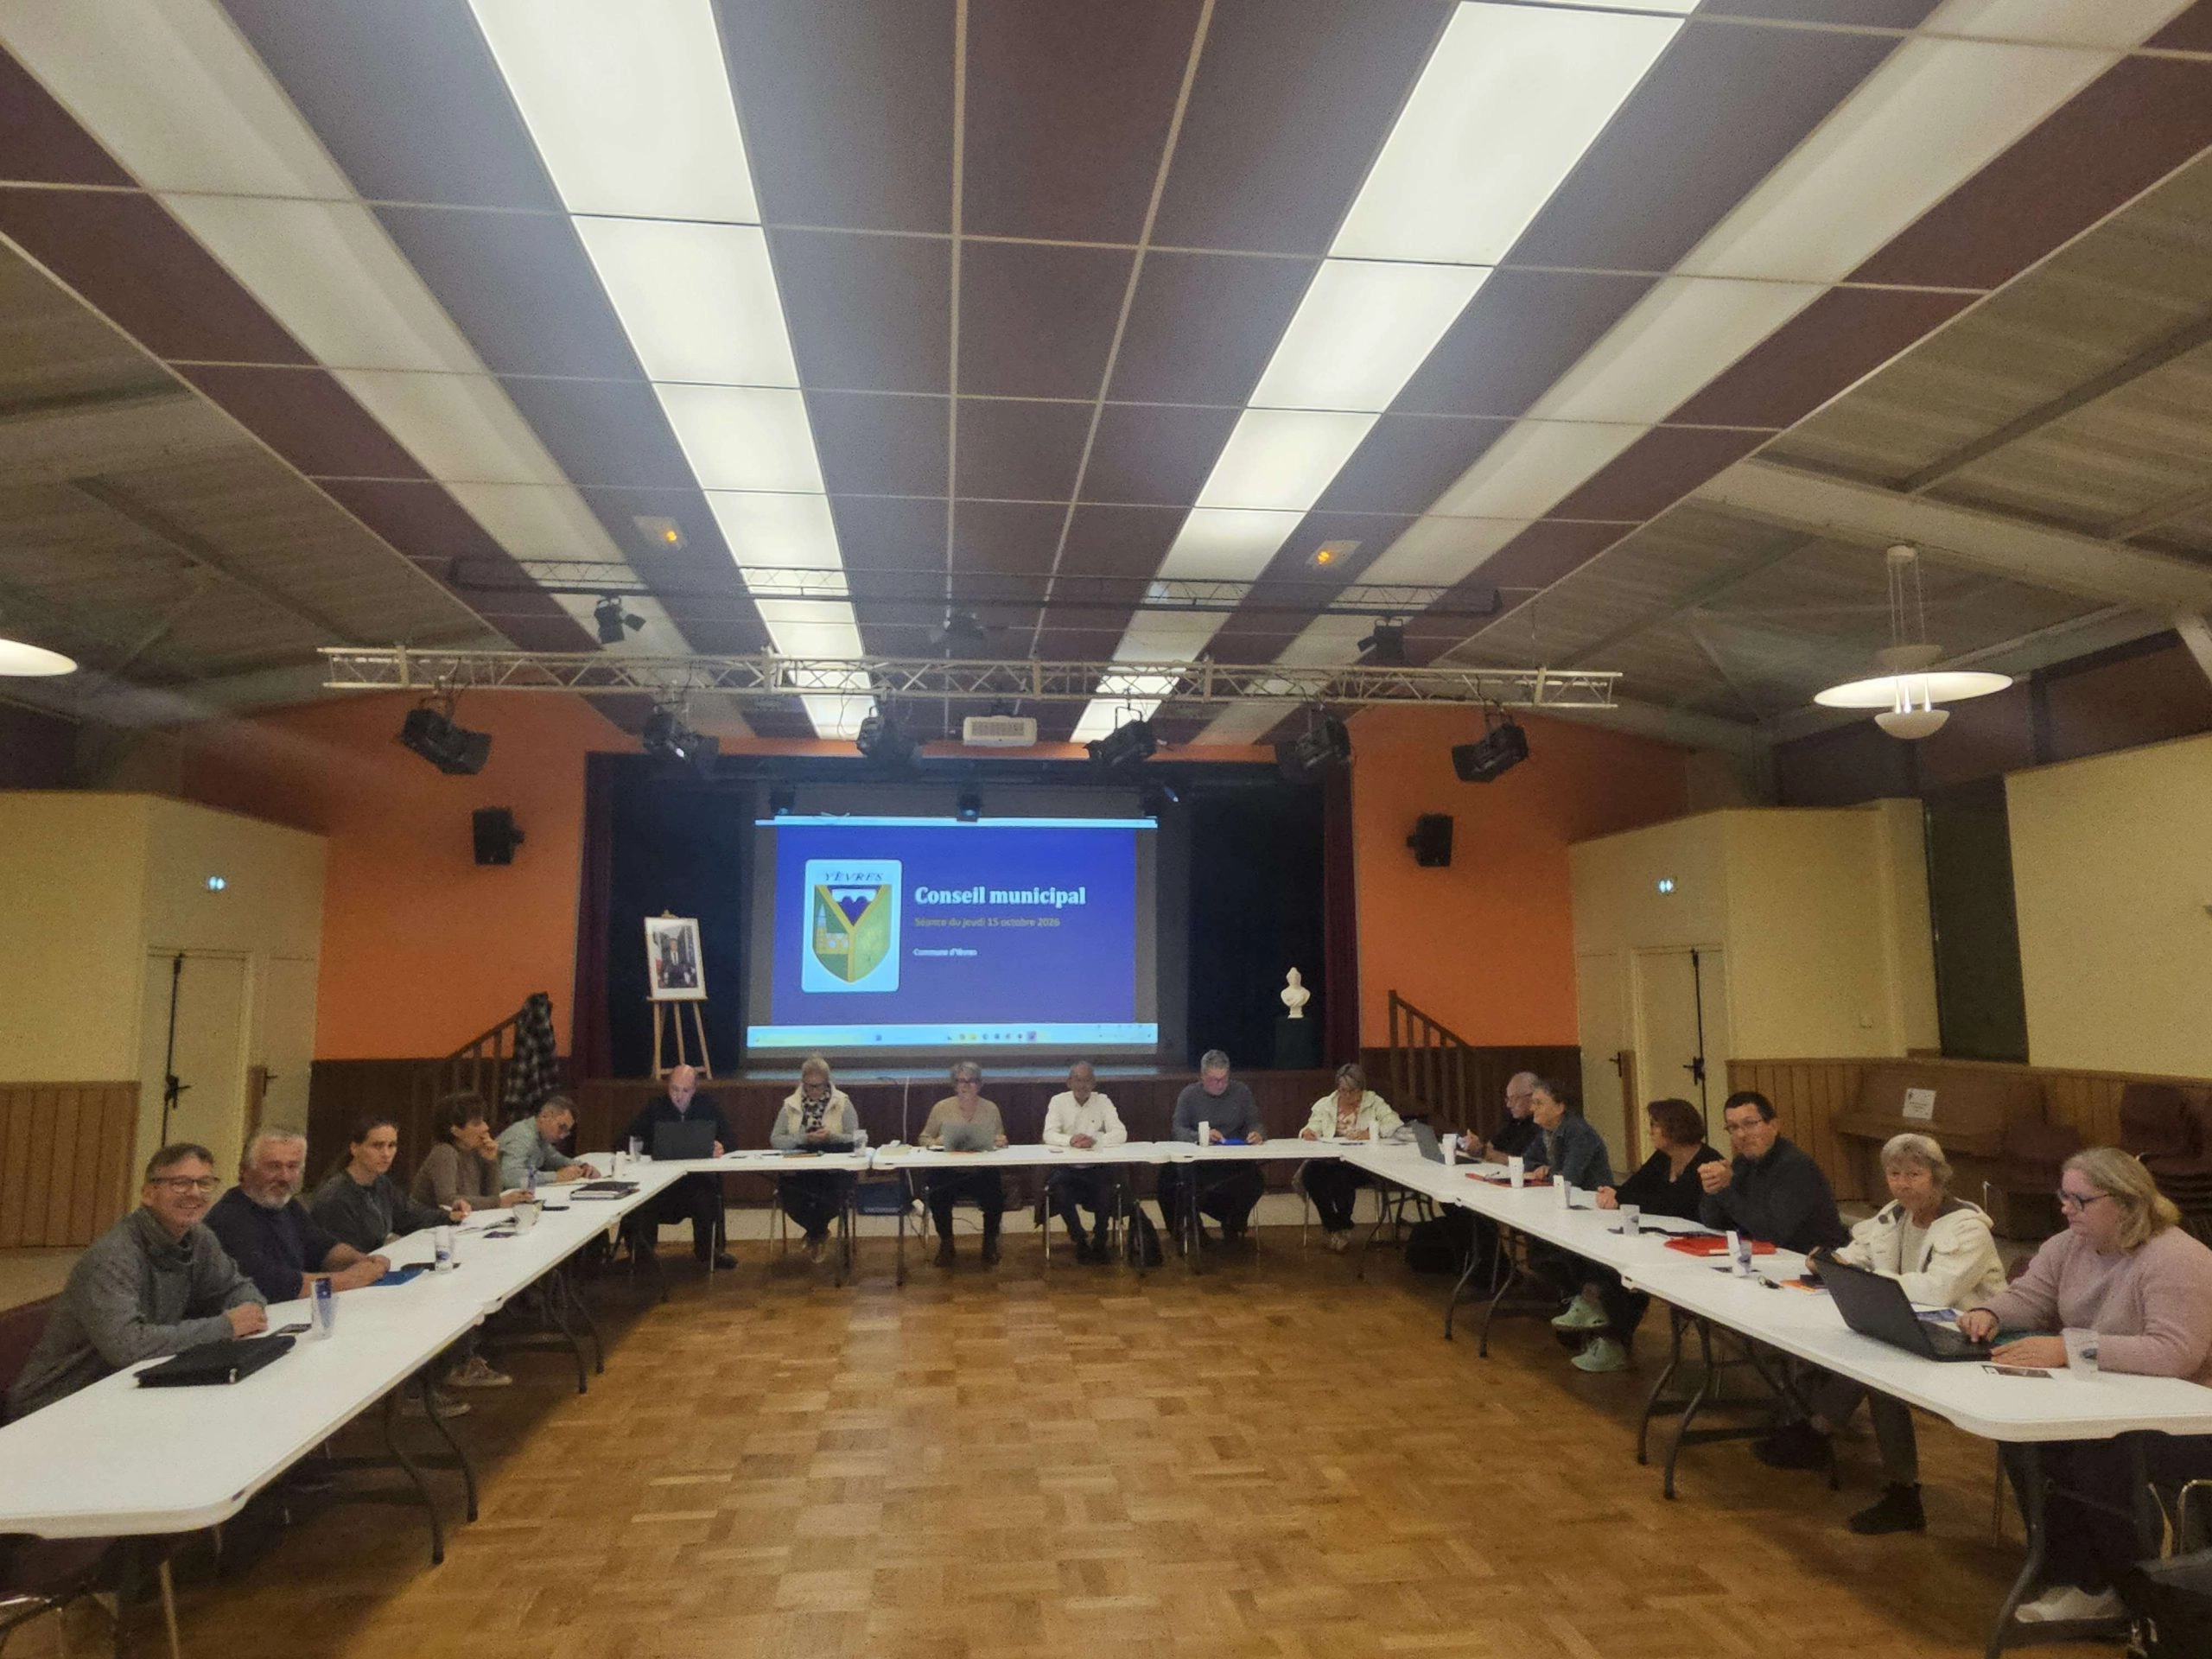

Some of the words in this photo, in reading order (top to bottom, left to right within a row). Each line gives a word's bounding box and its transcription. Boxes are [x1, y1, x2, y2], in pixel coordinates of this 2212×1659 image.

[915, 887, 986, 905] Conseil
[989, 887, 1086, 909] municipal
[988, 918, 999, 927] 15
